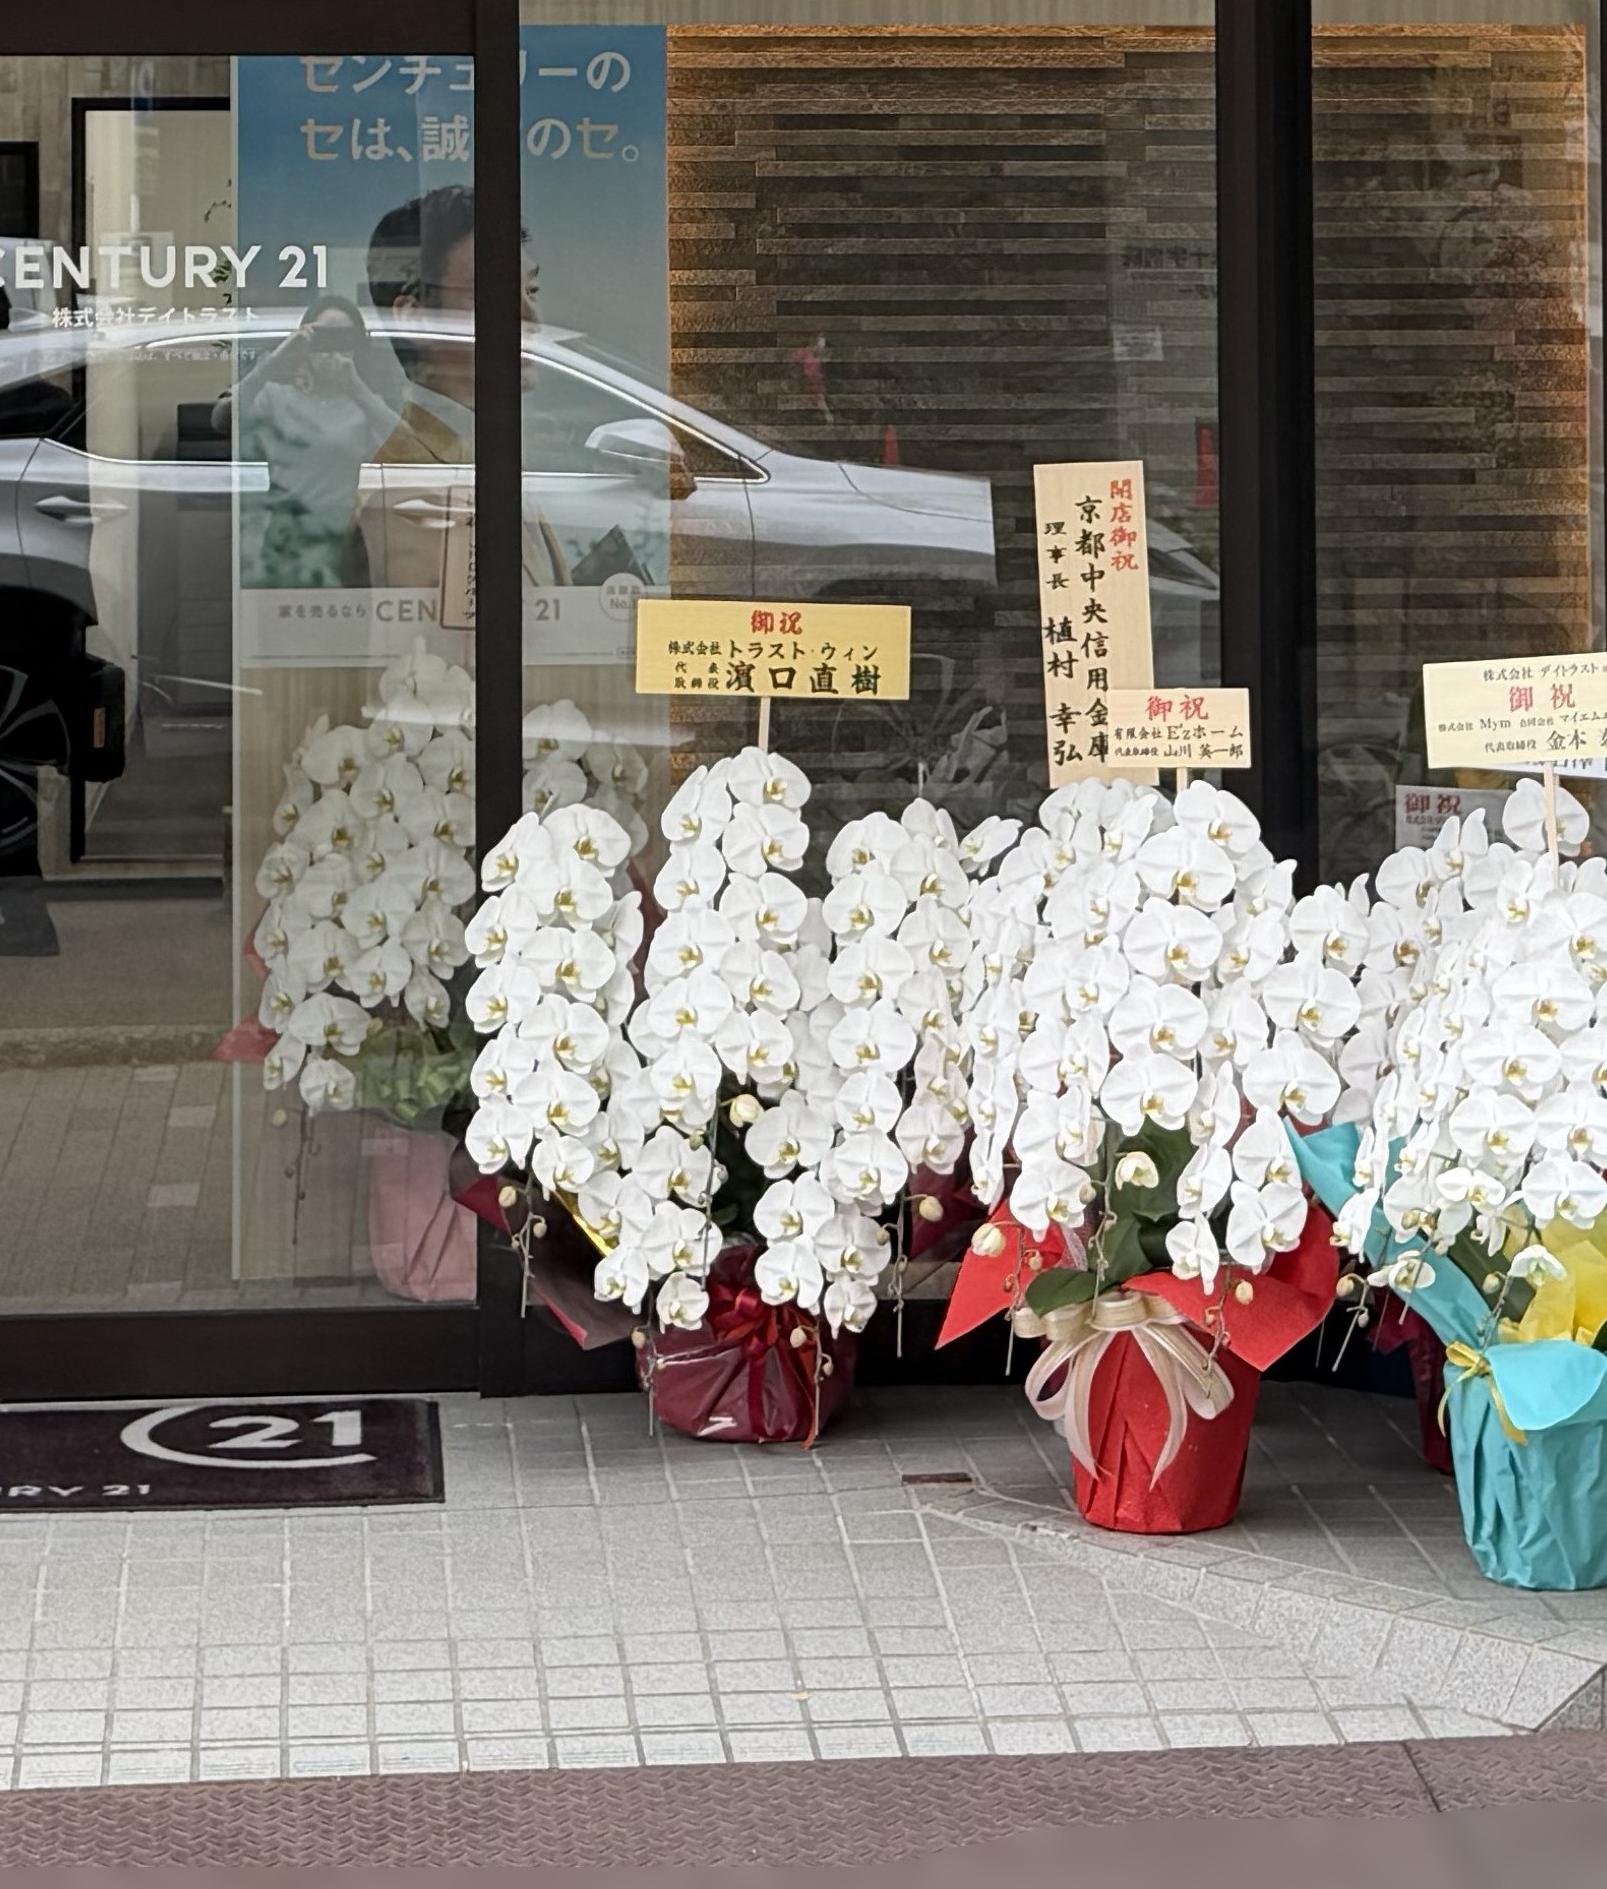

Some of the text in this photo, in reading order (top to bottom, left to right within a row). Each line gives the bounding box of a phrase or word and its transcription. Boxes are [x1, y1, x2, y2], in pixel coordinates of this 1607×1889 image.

[279, 245, 328, 289] 21
[1109, 478, 1139, 572] 開店御祝
[1044, 521, 1070, 590] 理事長
[535, 598, 561, 622] 21
[751, 609, 803, 635] 御祝
[1074, 495, 1110, 763] 京都中央信用金庫
[668, 640, 722, 656] 株式会社
[726, 661, 882, 696] 濱口直樹
[1483, 667, 1534, 682] 株式会社
[1540, 664, 1599, 679] デイトラスト
[1145, 694, 1209, 722] 御祝
[1508, 683, 1576, 712] 御祝
[209, 1409, 363, 1450] 21
[103, 1484, 151, 1498] 21
